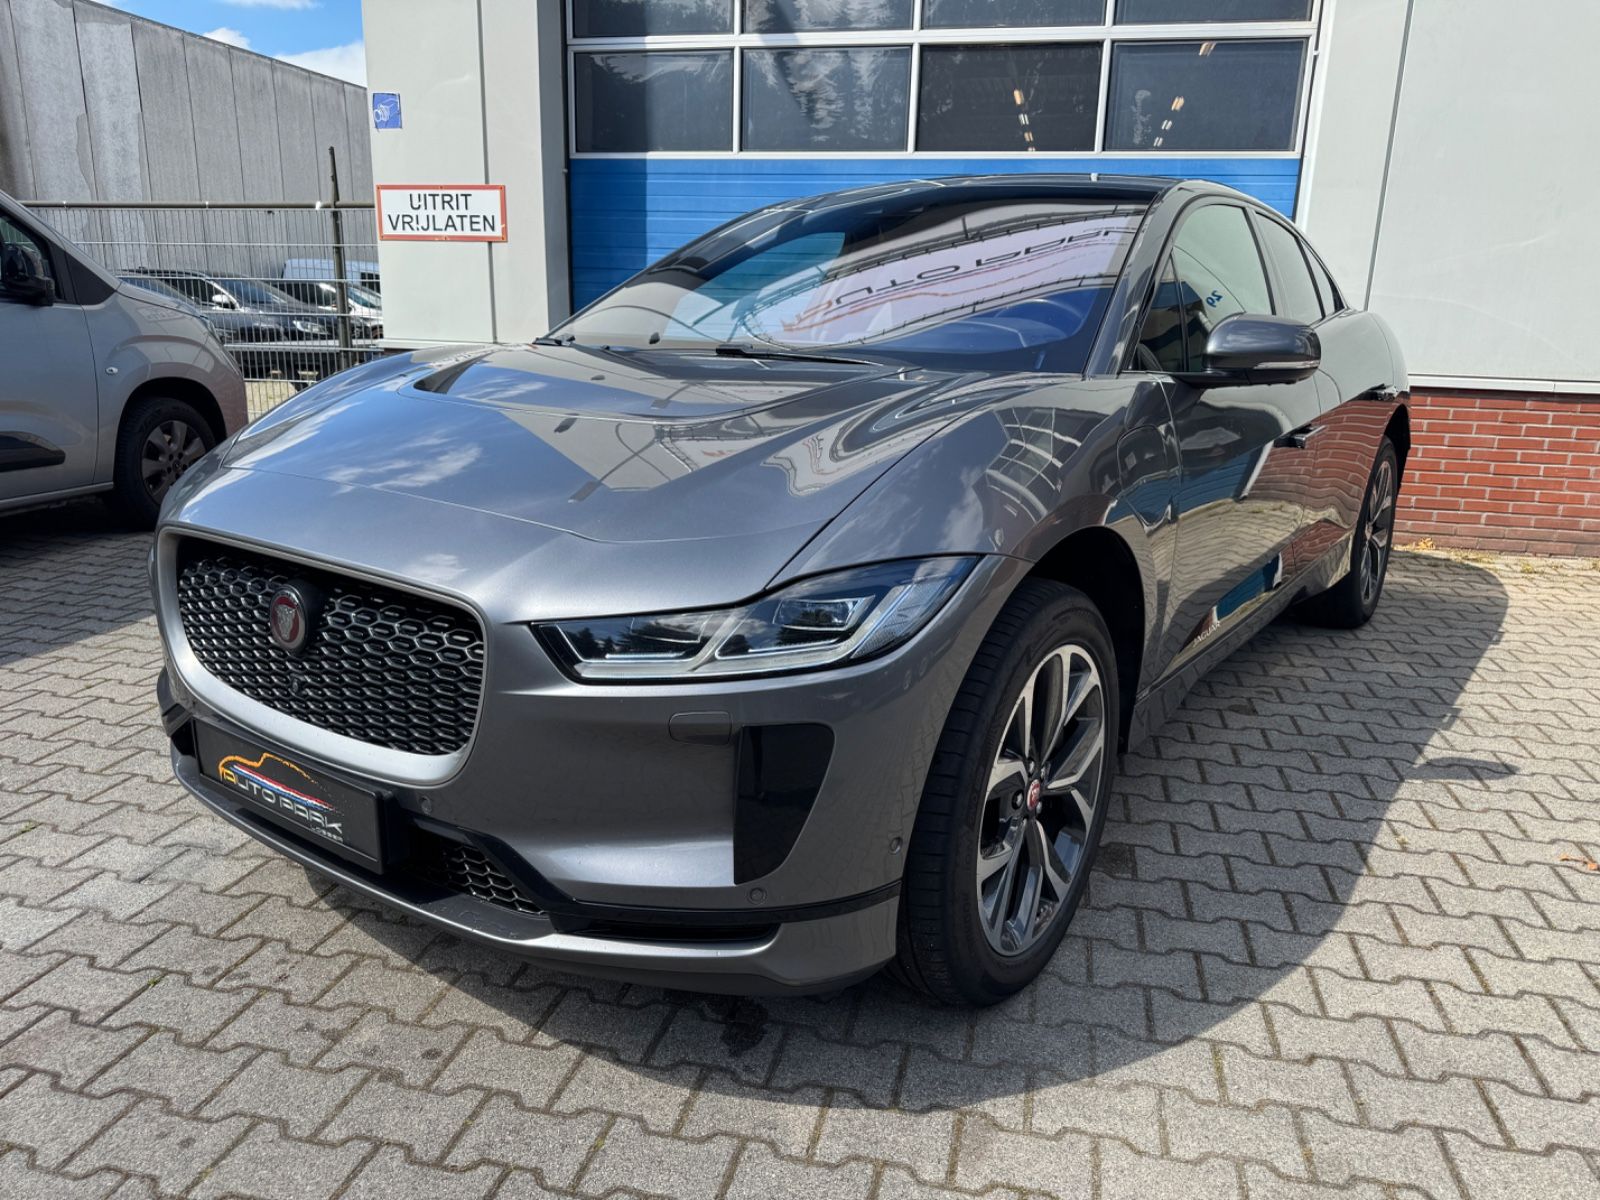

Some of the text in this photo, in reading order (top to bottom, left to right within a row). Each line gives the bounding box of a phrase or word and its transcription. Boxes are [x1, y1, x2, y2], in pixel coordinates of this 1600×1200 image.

[409, 193, 472, 211] UITRIT
[388, 214, 496, 232] VRIJLATEN
[1192, 620, 1221, 647] JAGUAR
